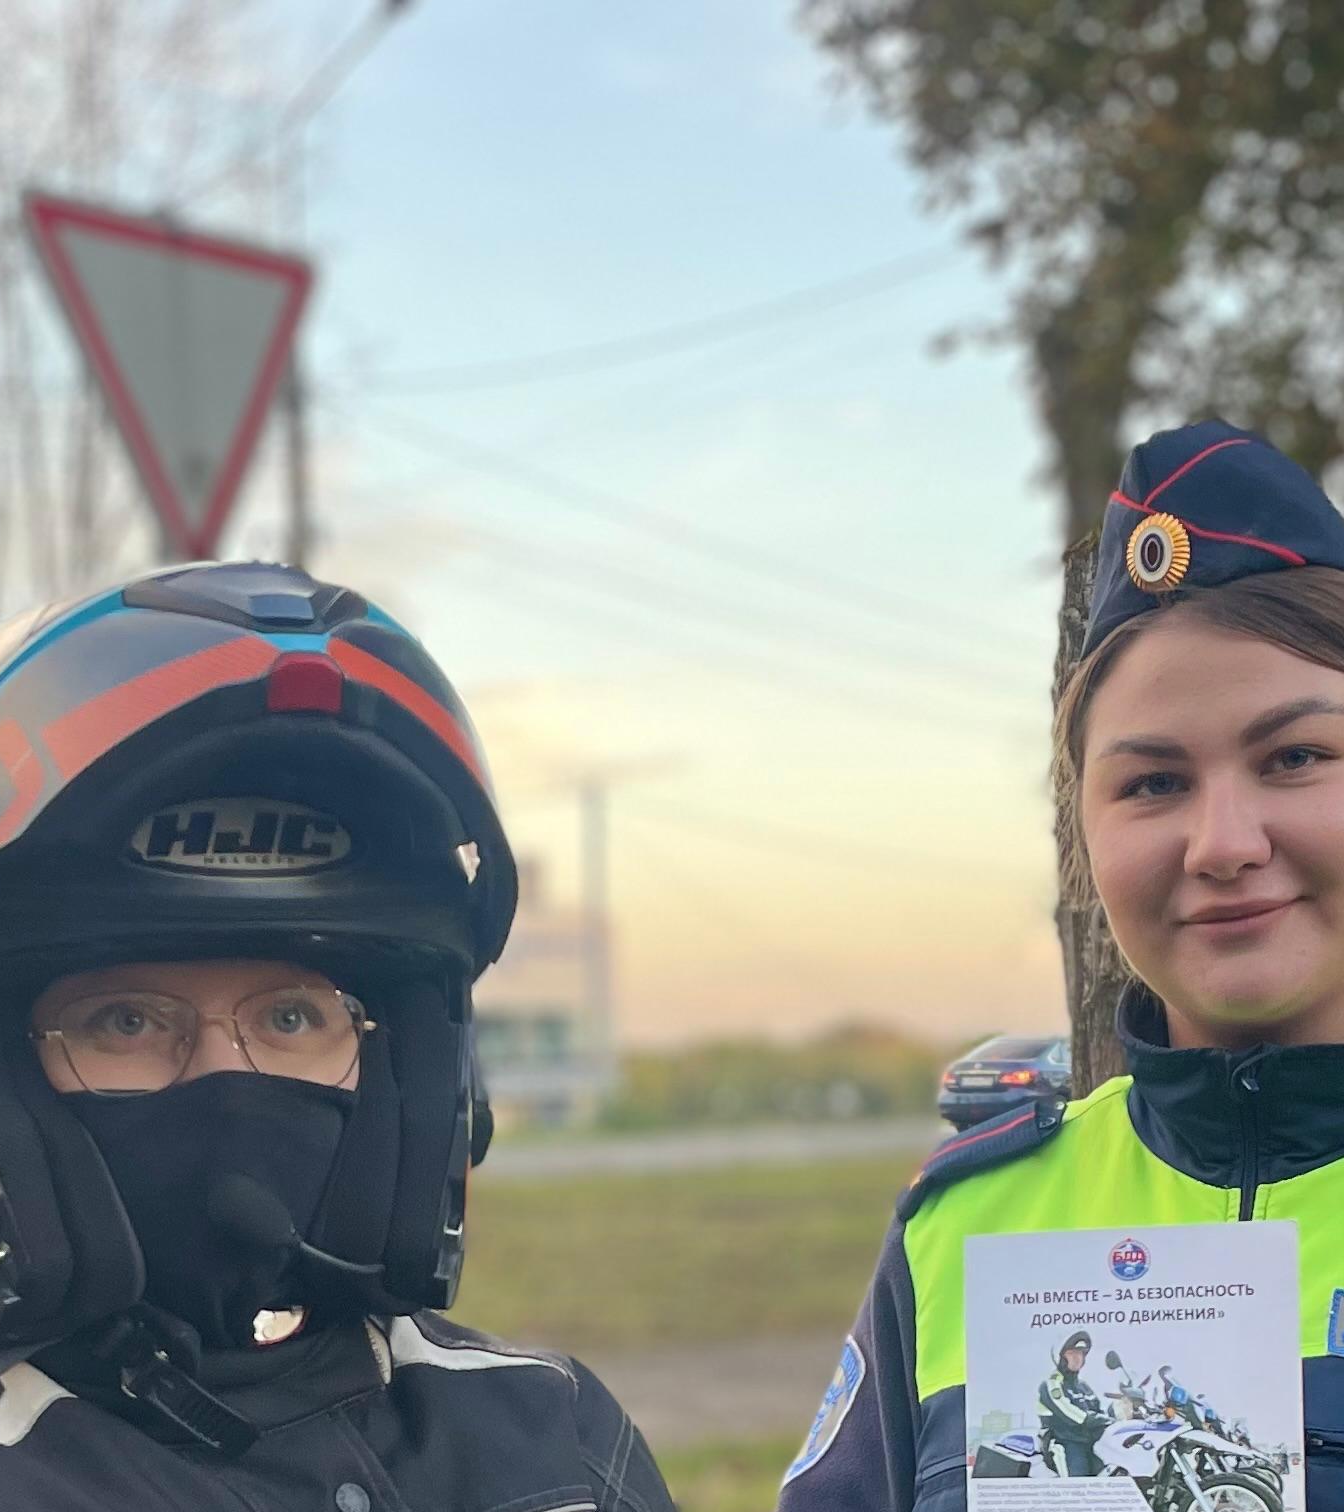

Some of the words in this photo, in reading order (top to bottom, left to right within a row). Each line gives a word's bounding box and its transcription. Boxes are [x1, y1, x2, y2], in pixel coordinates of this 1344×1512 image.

[147, 811, 338, 857] HJC
[1003, 1292, 1039, 1305] «МЫ
[1043, 1290, 1099, 1304] ВМЕСТЕ
[1115, 1288, 1133, 1301] ЗА
[1137, 1284, 1255, 1300] БЕЗОПАСНОСТЬ
[1030, 1311, 1126, 1328] ДОРОЖНОГО
[1128, 1307, 1225, 1325] ДВИЖЕНИЯ»
